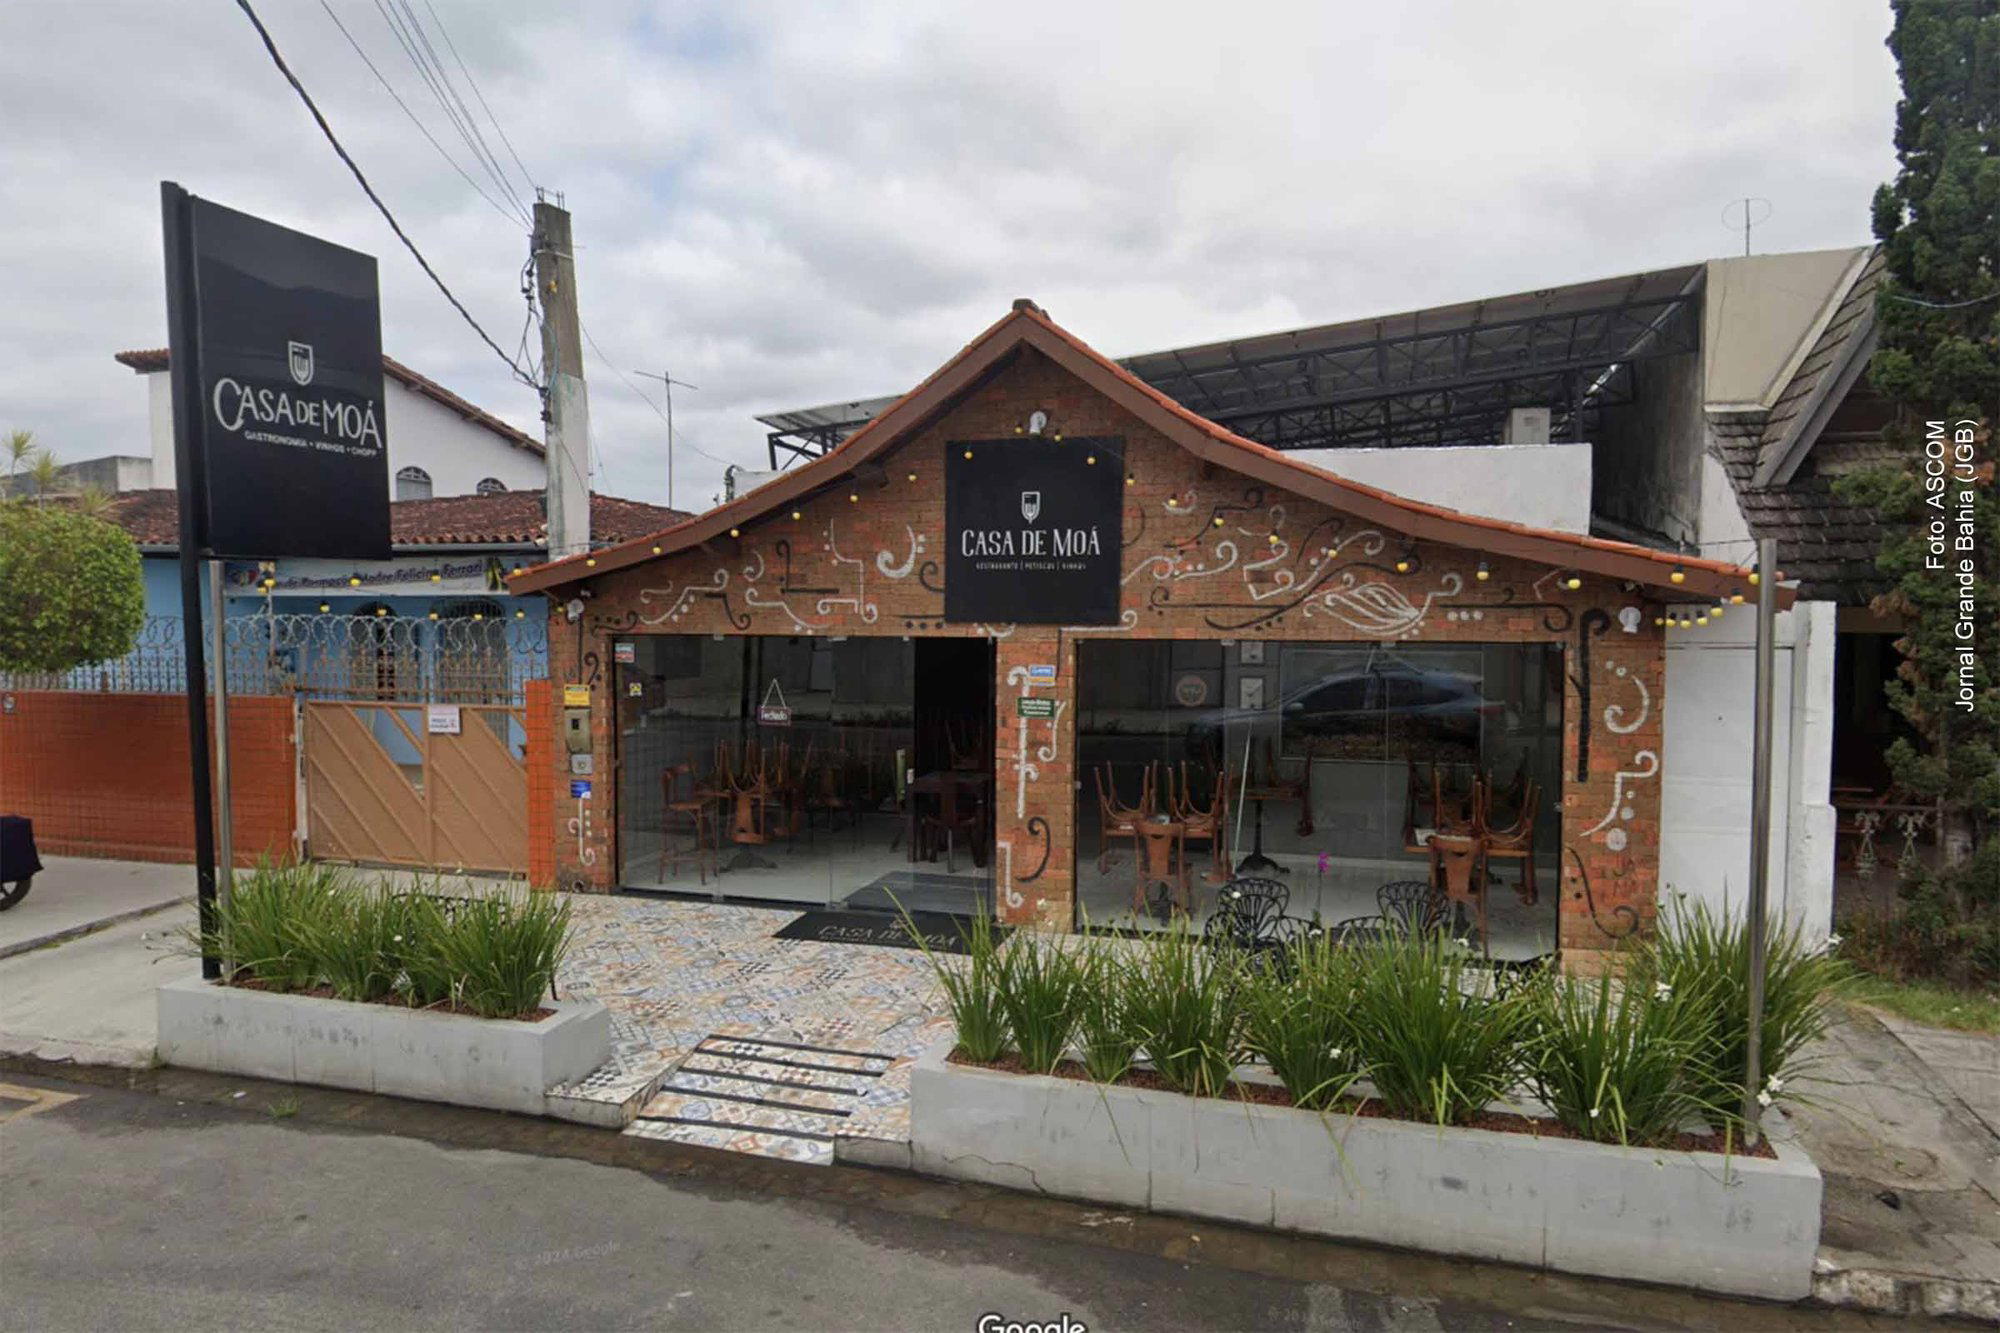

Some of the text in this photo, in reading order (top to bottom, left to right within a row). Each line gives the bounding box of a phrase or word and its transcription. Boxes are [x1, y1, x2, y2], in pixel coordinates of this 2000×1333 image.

[213, 377, 383, 449] CASA DE MOÁ
[961, 526, 1101, 557] CASA DE MOÁ
